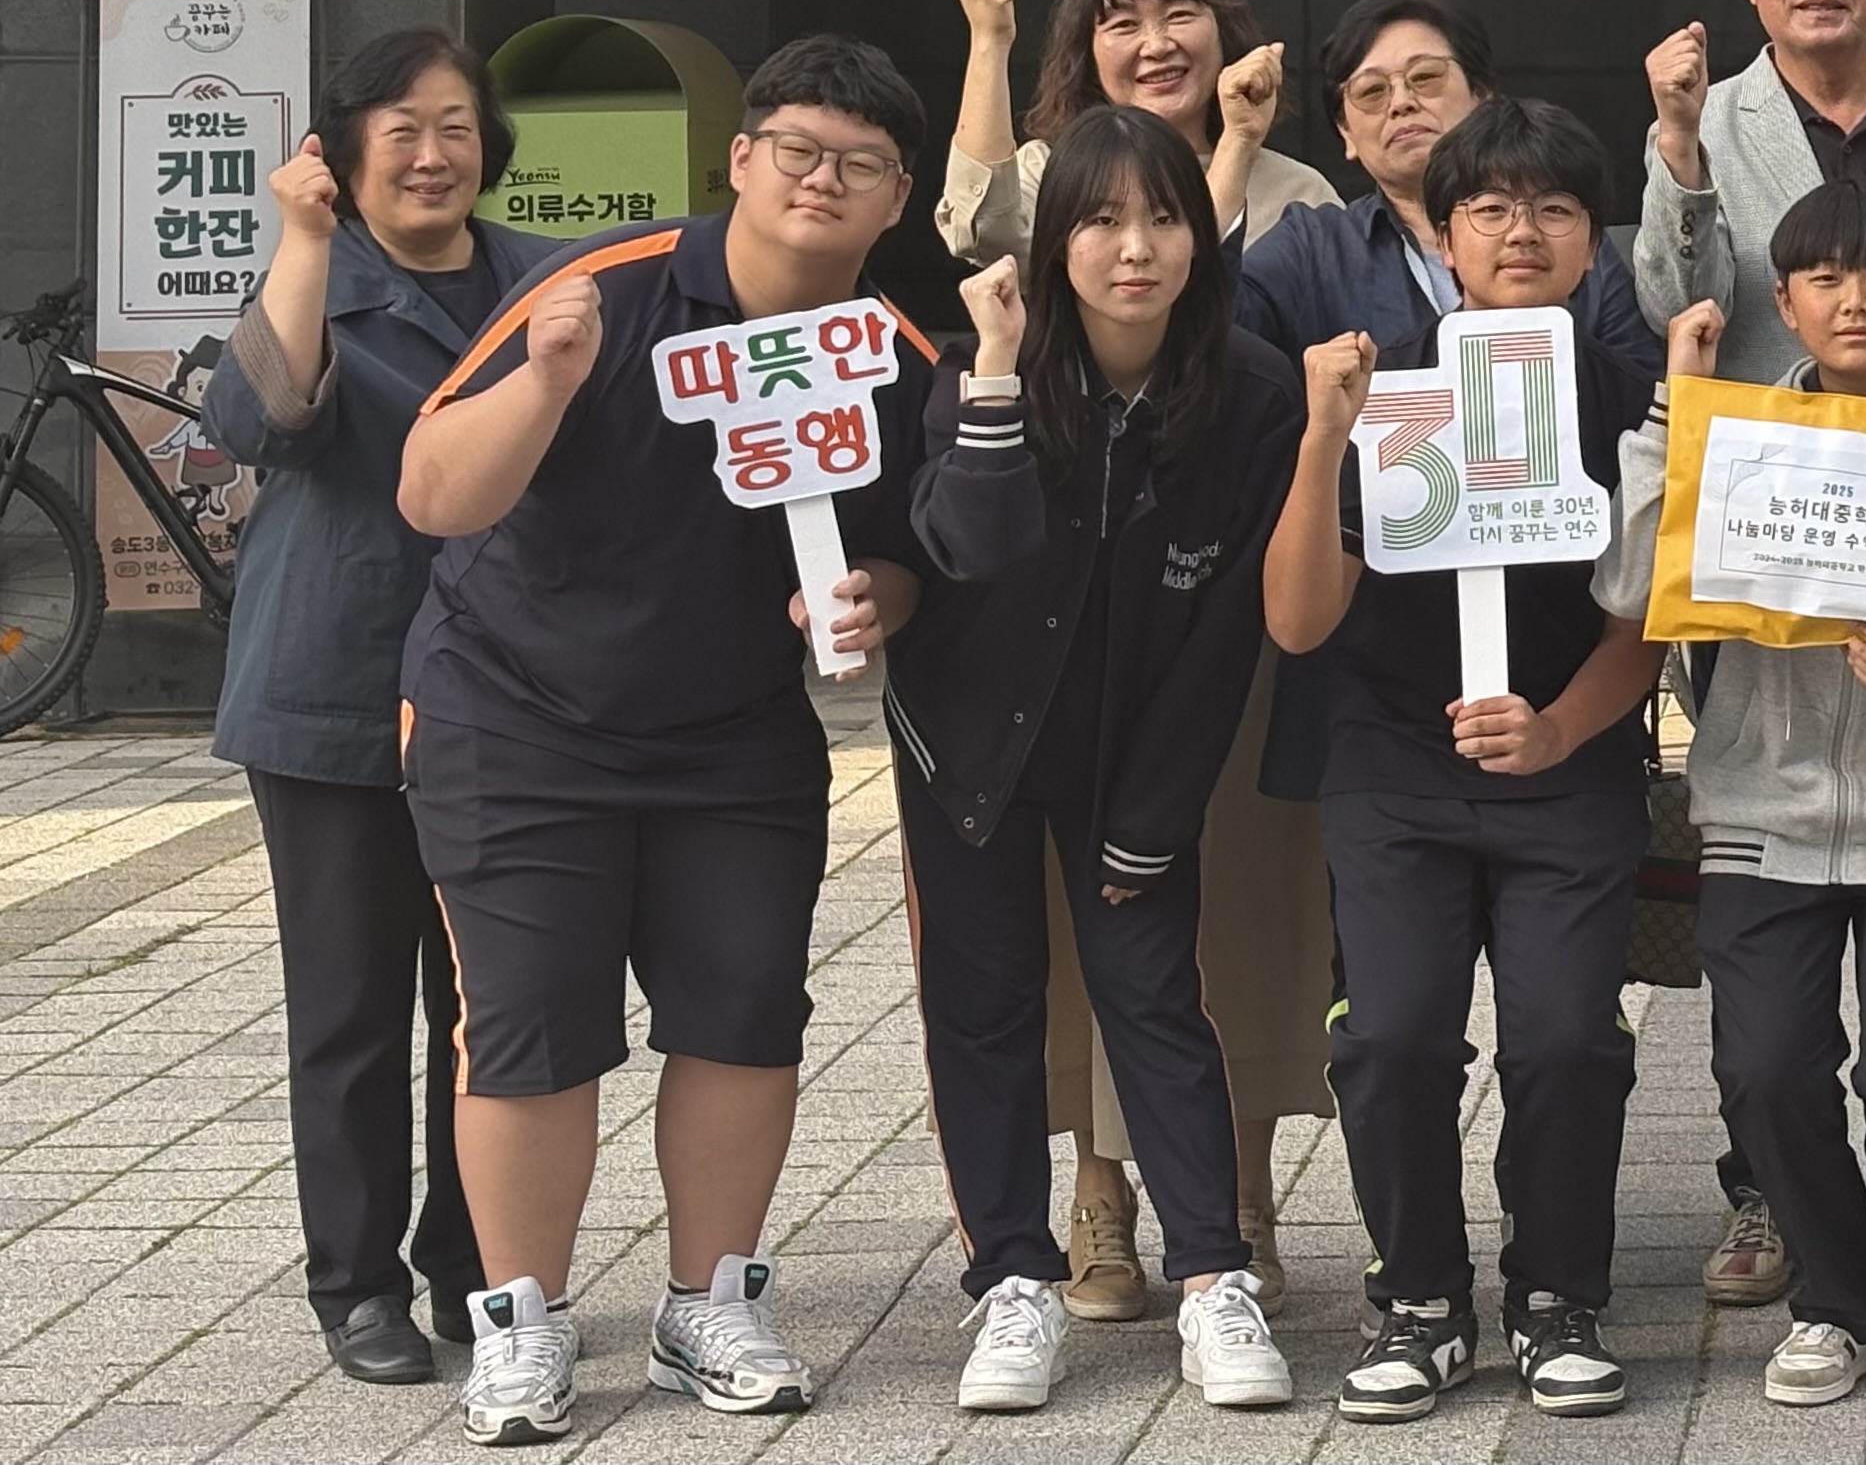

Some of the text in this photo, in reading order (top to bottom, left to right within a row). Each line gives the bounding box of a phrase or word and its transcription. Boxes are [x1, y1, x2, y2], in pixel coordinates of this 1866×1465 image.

[194, 22, 231, 36] 카페
[168, 112, 248, 138] 맛있는
[157, 149, 255, 198] 커피
[507, 192, 657, 223] 의류수거함
[154, 206, 260, 259] 한잔
[158, 271, 256, 296] 어때요?
[668, 311, 888, 404] 따뜻한
[727, 404, 870, 491] 동행
[1822, 483, 1855, 498] 2025
[1467, 501, 1503, 522] 함께
[1511, 499, 1545, 518] 이룬
[1469, 519, 1598, 544] 다시 꿈꾸는 연수
[1728, 518, 1795, 543] 나눔마당
[1803, 527, 1837, 547] 운영
